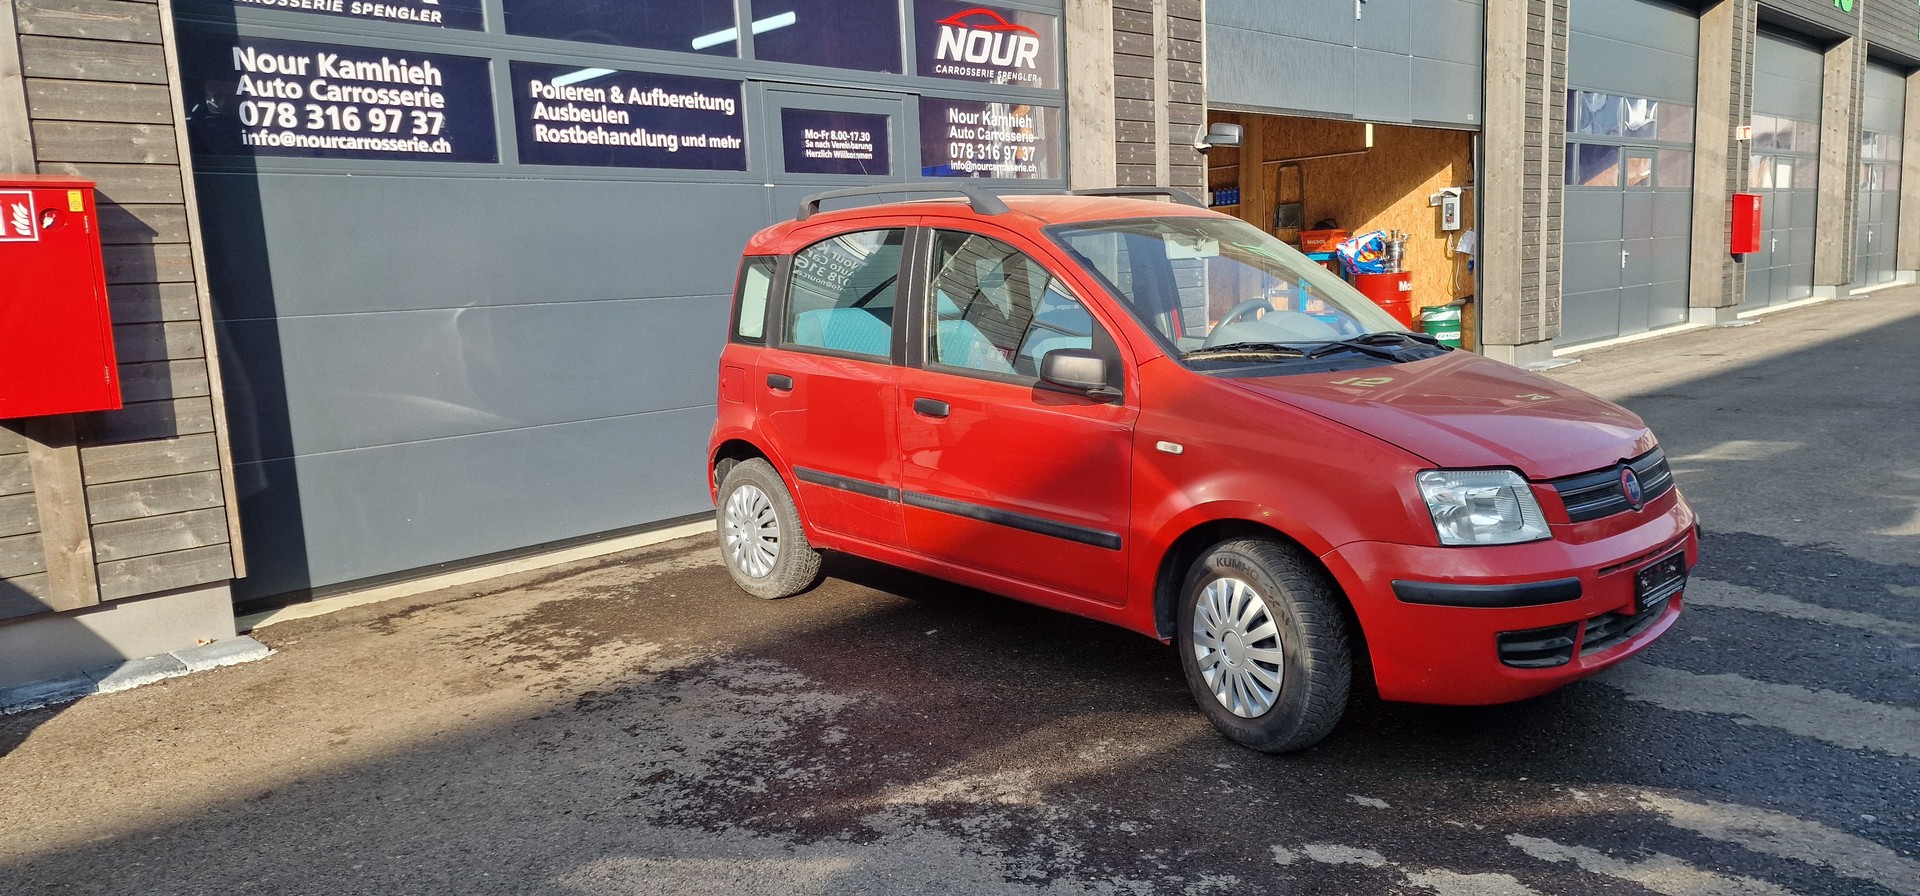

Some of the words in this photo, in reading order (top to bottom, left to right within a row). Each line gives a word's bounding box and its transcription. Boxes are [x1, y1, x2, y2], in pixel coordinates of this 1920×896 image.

[350, 2, 443, 24] SPENGLER
[937, 25, 1040, 69] NOUR
[232, 46, 311, 76] Nour
[317, 52, 443, 86] Kamhieh
[935, 65, 994, 78] CARROSSERIE
[998, 70, 1038, 82] SPENGLER
[236, 74, 303, 99] Auto
[309, 79, 445, 108] Carrosserie
[530, 79, 606, 103] Polieren
[609, 86, 625, 104] &
[628, 87, 735, 115] Aufbereitung
[239, 100, 298, 128] 078
[305, 103, 361, 131] 316
[368, 107, 403, 133] 97
[411, 110, 444, 135] 37
[533, 101, 630, 125] Ausbeulen
[949, 107, 980, 125] Nour
[982, 110, 1032, 128] Kamhieh
[241, 129, 453, 154] info@nourcarrosserie.ch
[535, 123, 679, 152] Rostbehandlung
[681, 134, 706, 149] und
[709, 135, 742, 149] mehr
[804, 128, 829, 140] Mo-Fr
[830, 130, 871, 142] 8.00-17.30
[949, 125, 975, 140] Auto
[977, 127, 1034, 143] Carrosserie
[805, 139, 814, 149] Sa
[815, 140, 830, 149] nach
[831, 140, 873, 152] Vereinbarung
[805, 149, 833, 160] Herzlich
[833, 150, 873, 161] Willkommen
[950, 142, 974, 159] 078
[977, 143, 1000, 160] 316
[1003, 145, 1018, 161] 97
[1021, 146, 1036, 162] 37
[950, 160, 1037, 173] info@nourcarrosserie.ch
[1215, 557, 1260, 580] KUMHO
